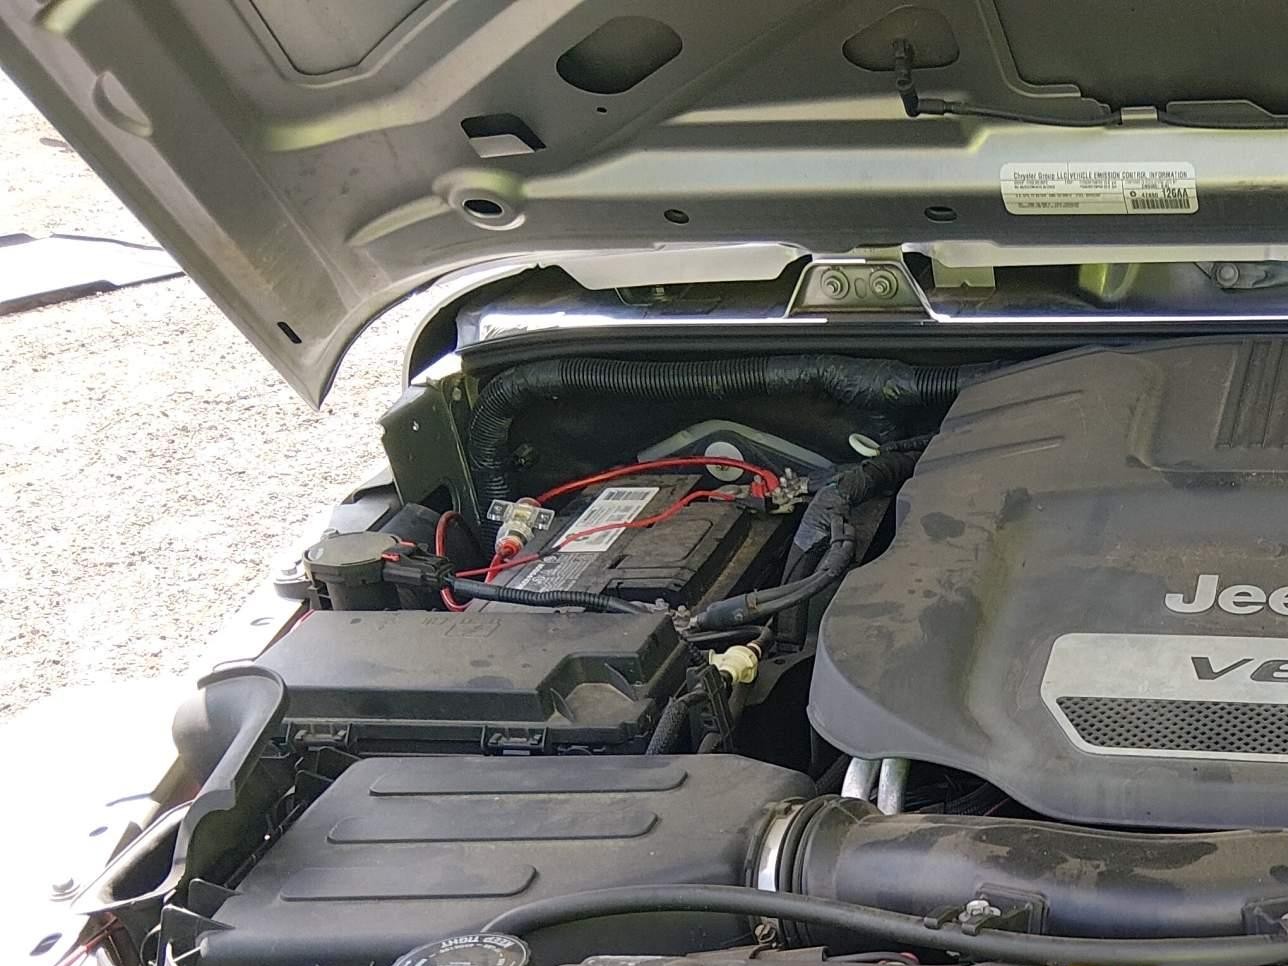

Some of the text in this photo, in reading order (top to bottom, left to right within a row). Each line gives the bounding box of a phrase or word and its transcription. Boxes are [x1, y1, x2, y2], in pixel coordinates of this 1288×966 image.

[1038, 172, 1055, 181] Group
[1148, 171, 1187, 179] INFORMATION
[440, 935, 516, 949] KEEP TIGHT
